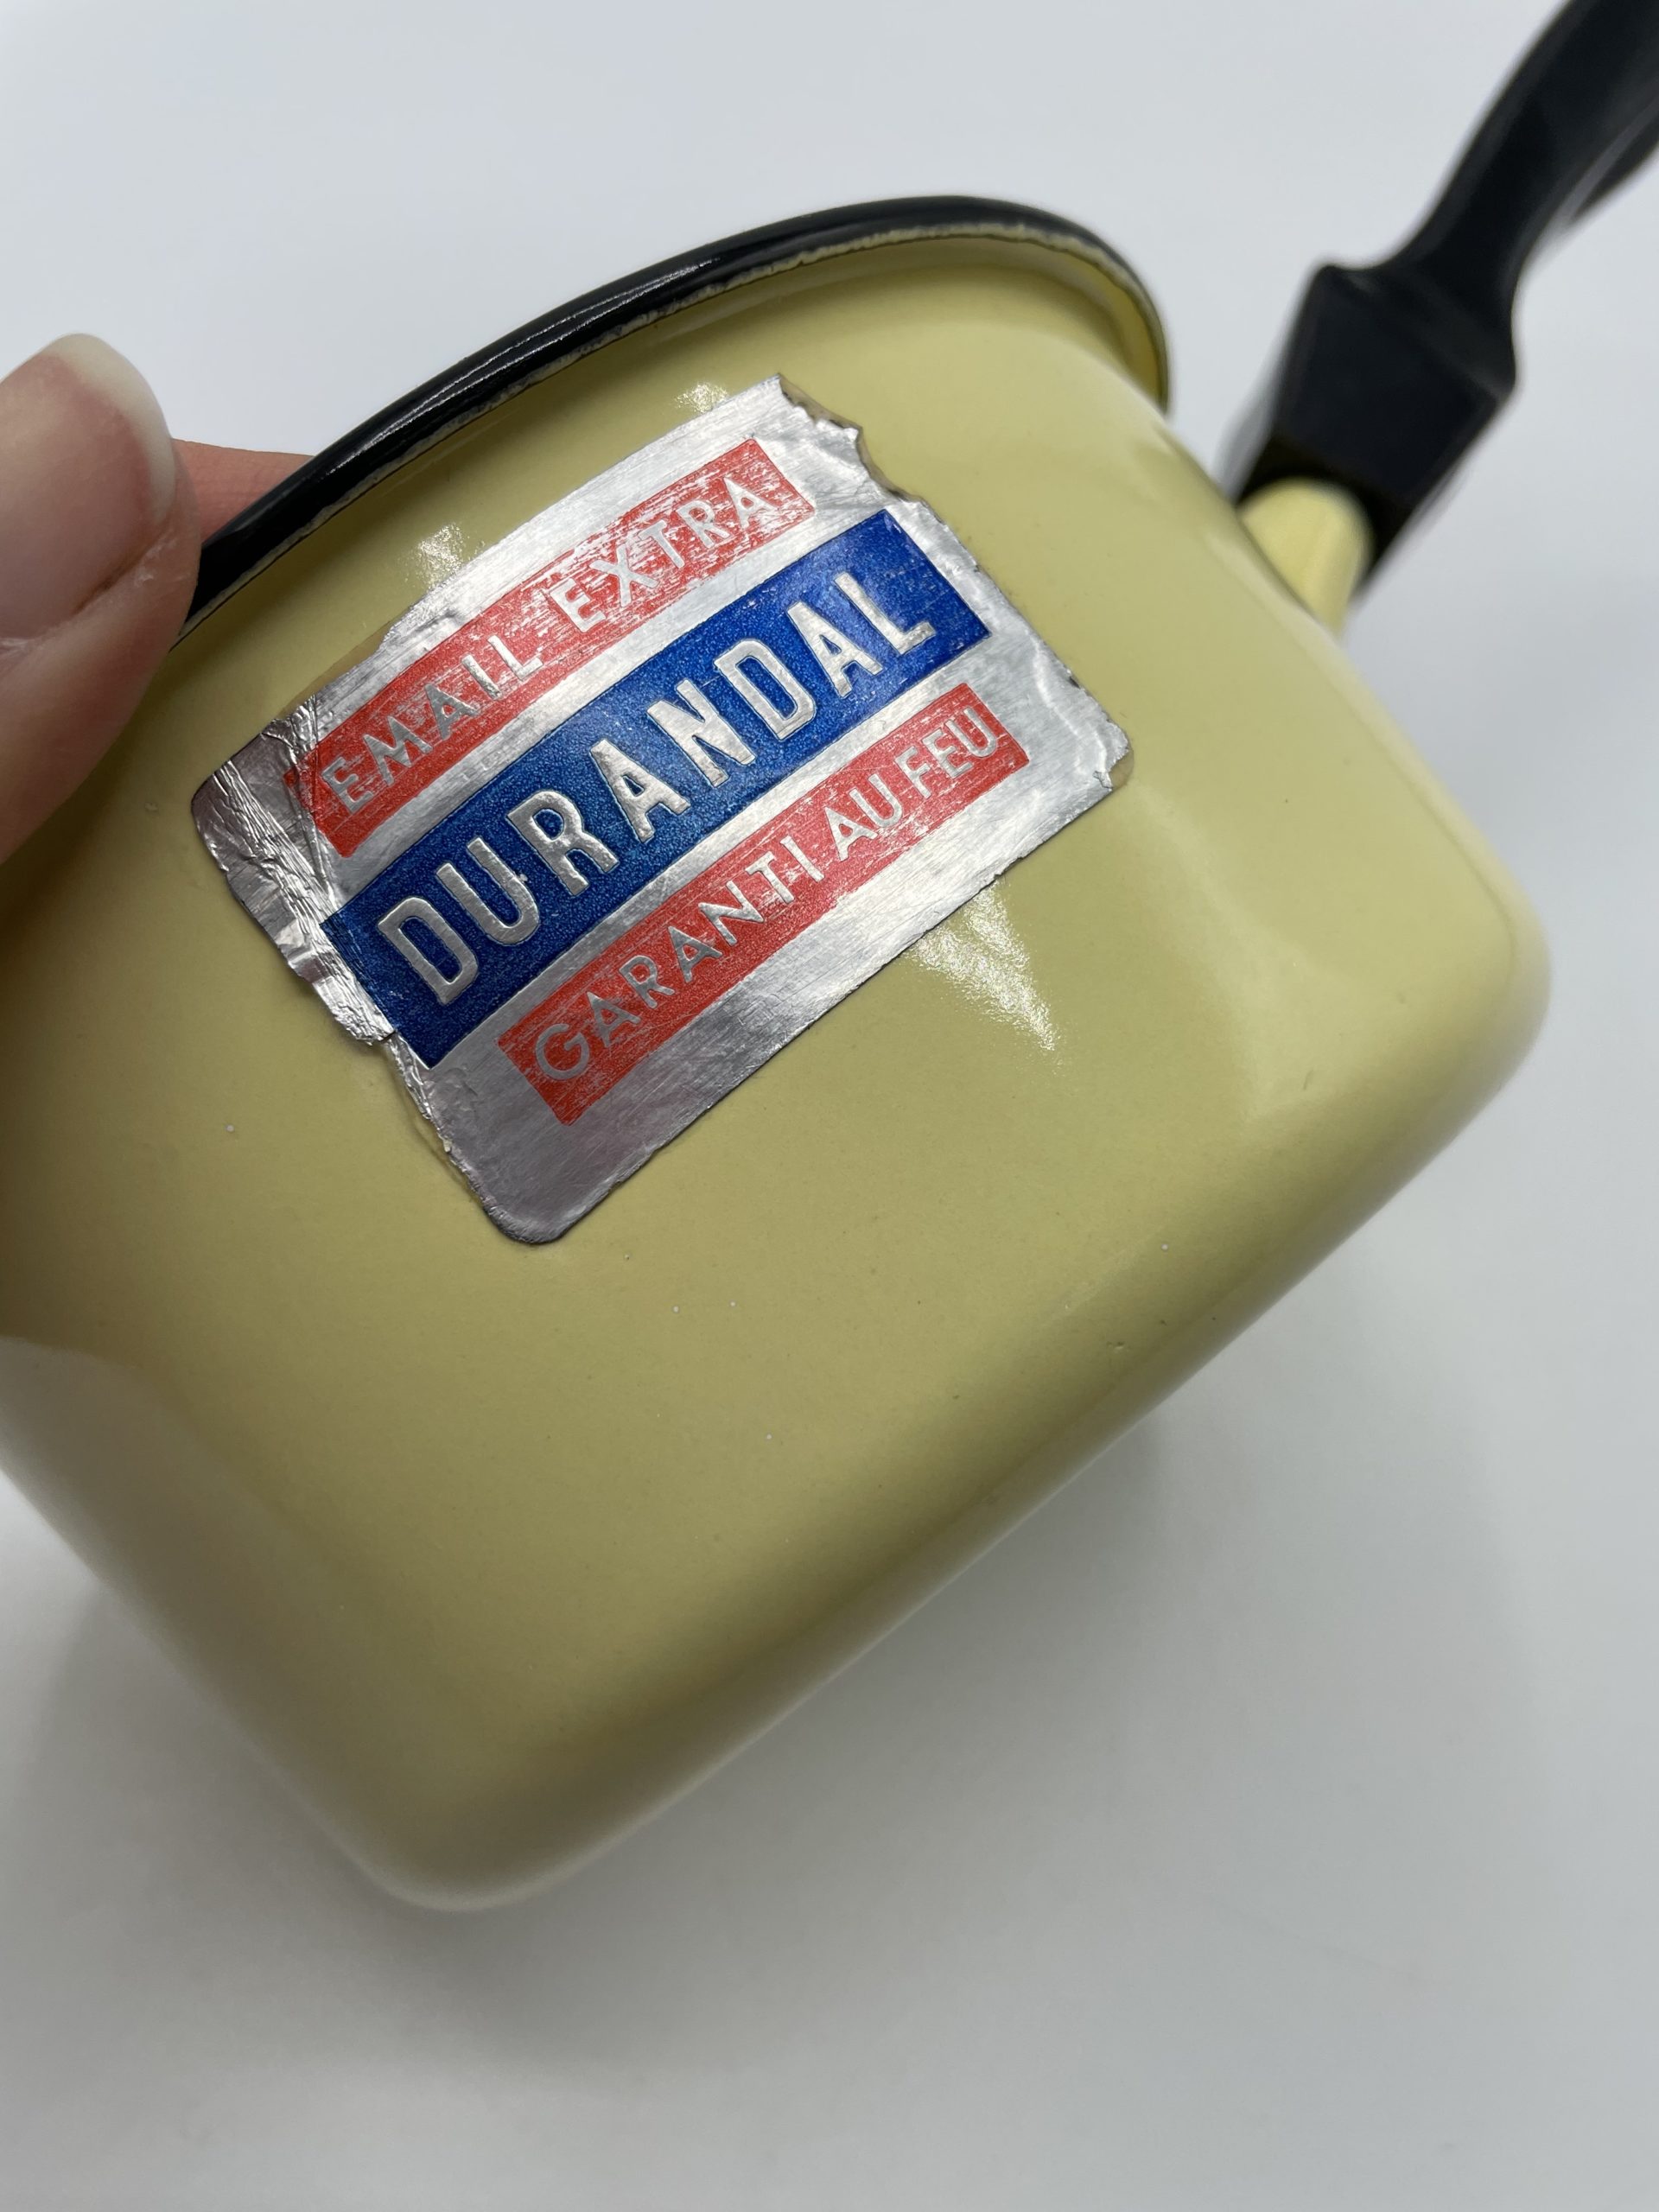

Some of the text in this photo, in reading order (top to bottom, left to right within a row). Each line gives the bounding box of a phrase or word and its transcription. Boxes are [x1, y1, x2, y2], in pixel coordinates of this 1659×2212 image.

[321, 476, 779, 814] EMAIL EXTRA
[378, 572, 936, 1005] DURANDAL
[534, 705, 998, 1080] GARANTI AU FEU
